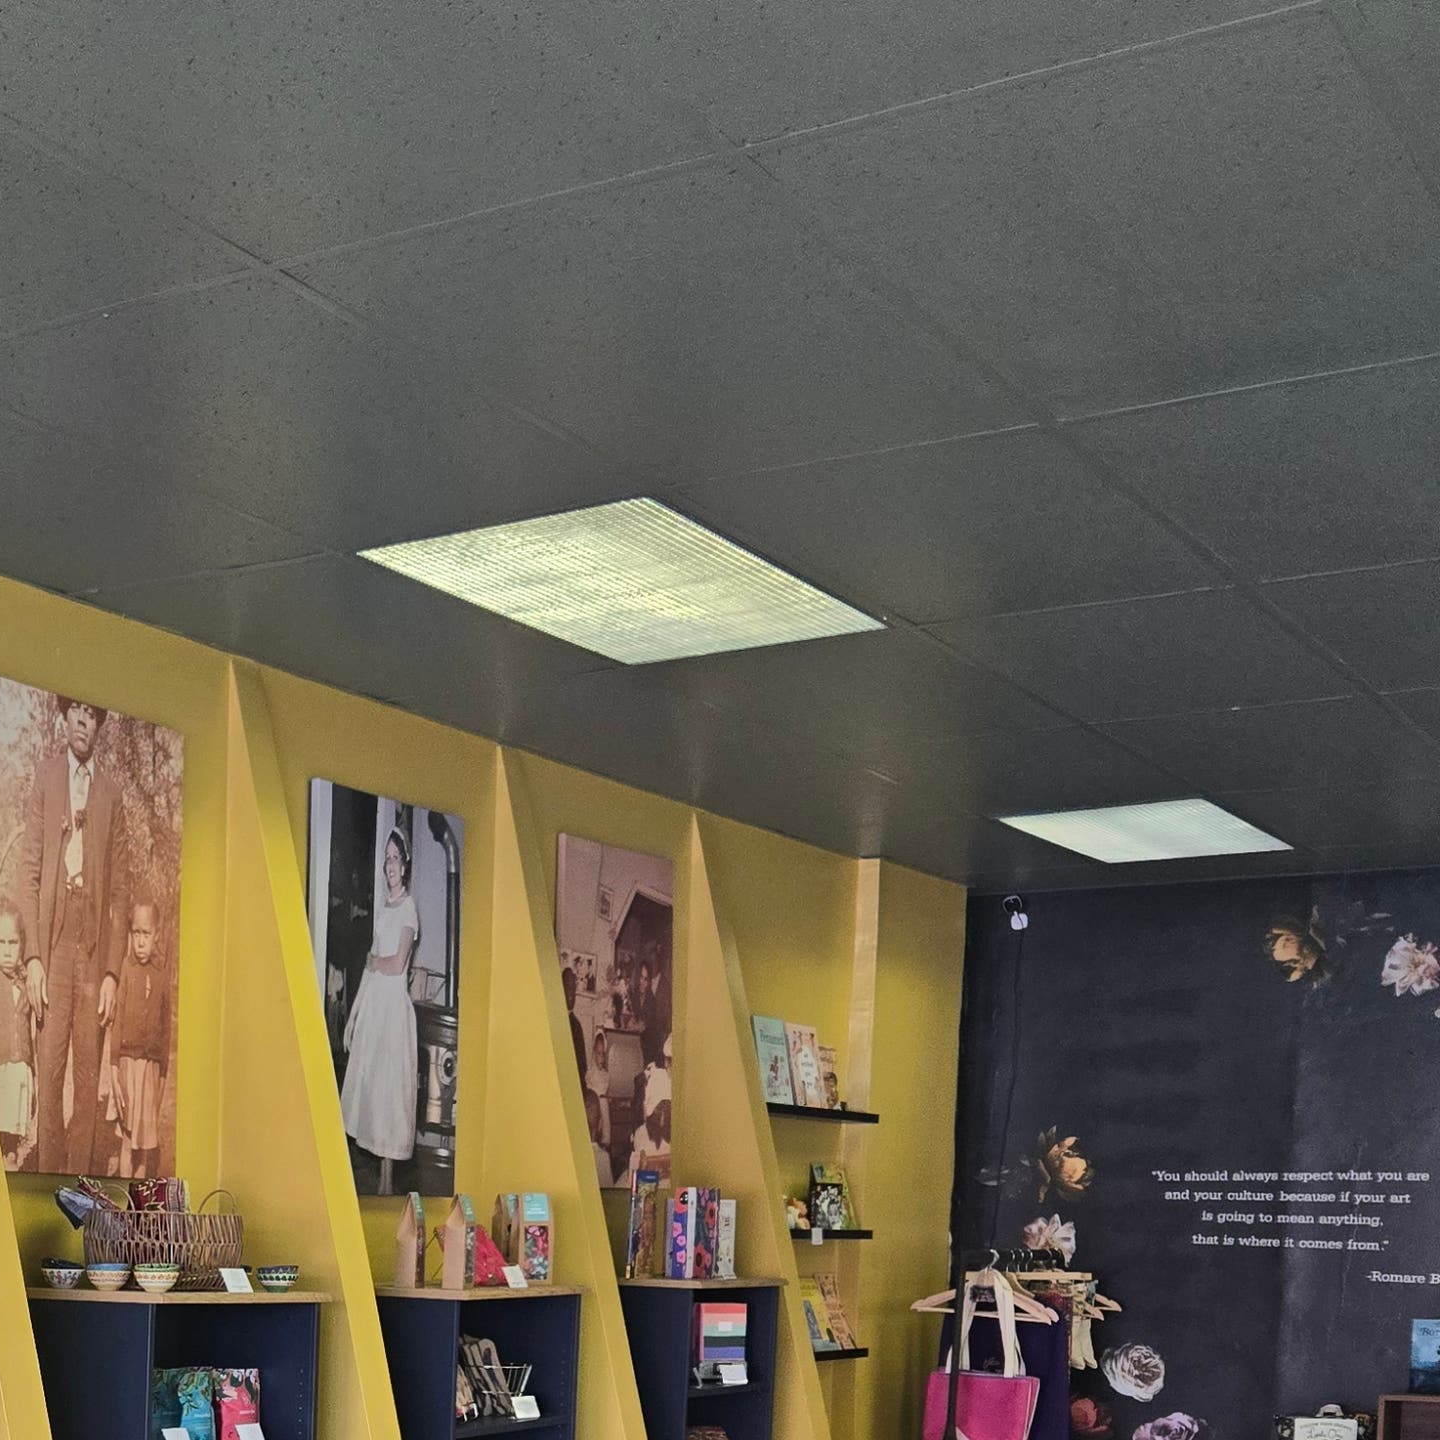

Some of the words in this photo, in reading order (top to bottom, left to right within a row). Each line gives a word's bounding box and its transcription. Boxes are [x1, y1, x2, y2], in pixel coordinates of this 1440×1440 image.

[1151, 1169, 1181, 1182] "You
[1183, 1169, 1229, 1182] should
[1231, 1169, 1279, 1183] always
[1282, 1170, 1334, 1184] respect
[1335, 1169, 1373, 1182] what
[1375, 1171, 1403, 1184] you
[1405, 1172, 1430, 1182] are
[1164, 1188, 1190, 1201] and
[1192, 1190, 1224, 1204] your
[1226, 1189, 1275, 1202] culture
[1278, 1190, 1337, 1203] because
[1339, 1190, 1351, 1203] if
[1353, 1193, 1386, 1206] your
[1389, 1193, 1412, 1204] art
[1200, 1209, 1214, 1222] is
[1216, 1210, 1256, 1225] going
[1257, 1212, 1273, 1224] to
[1276, 1214, 1315, 1225] mean
[1317, 1213, 1384, 1228] anything,
[1191, 1233, 1220, 1246] that
[1222, 1233, 1236, 1247] is
[1237, 1235, 1281, 1248] where
[1283, 1236, 1295, 1249] it
[1297, 1239, 1344, 1251] comes
[1346, 1238, 1390, 1252] from."
[1365, 1270, 1426, 1284] -Romare
